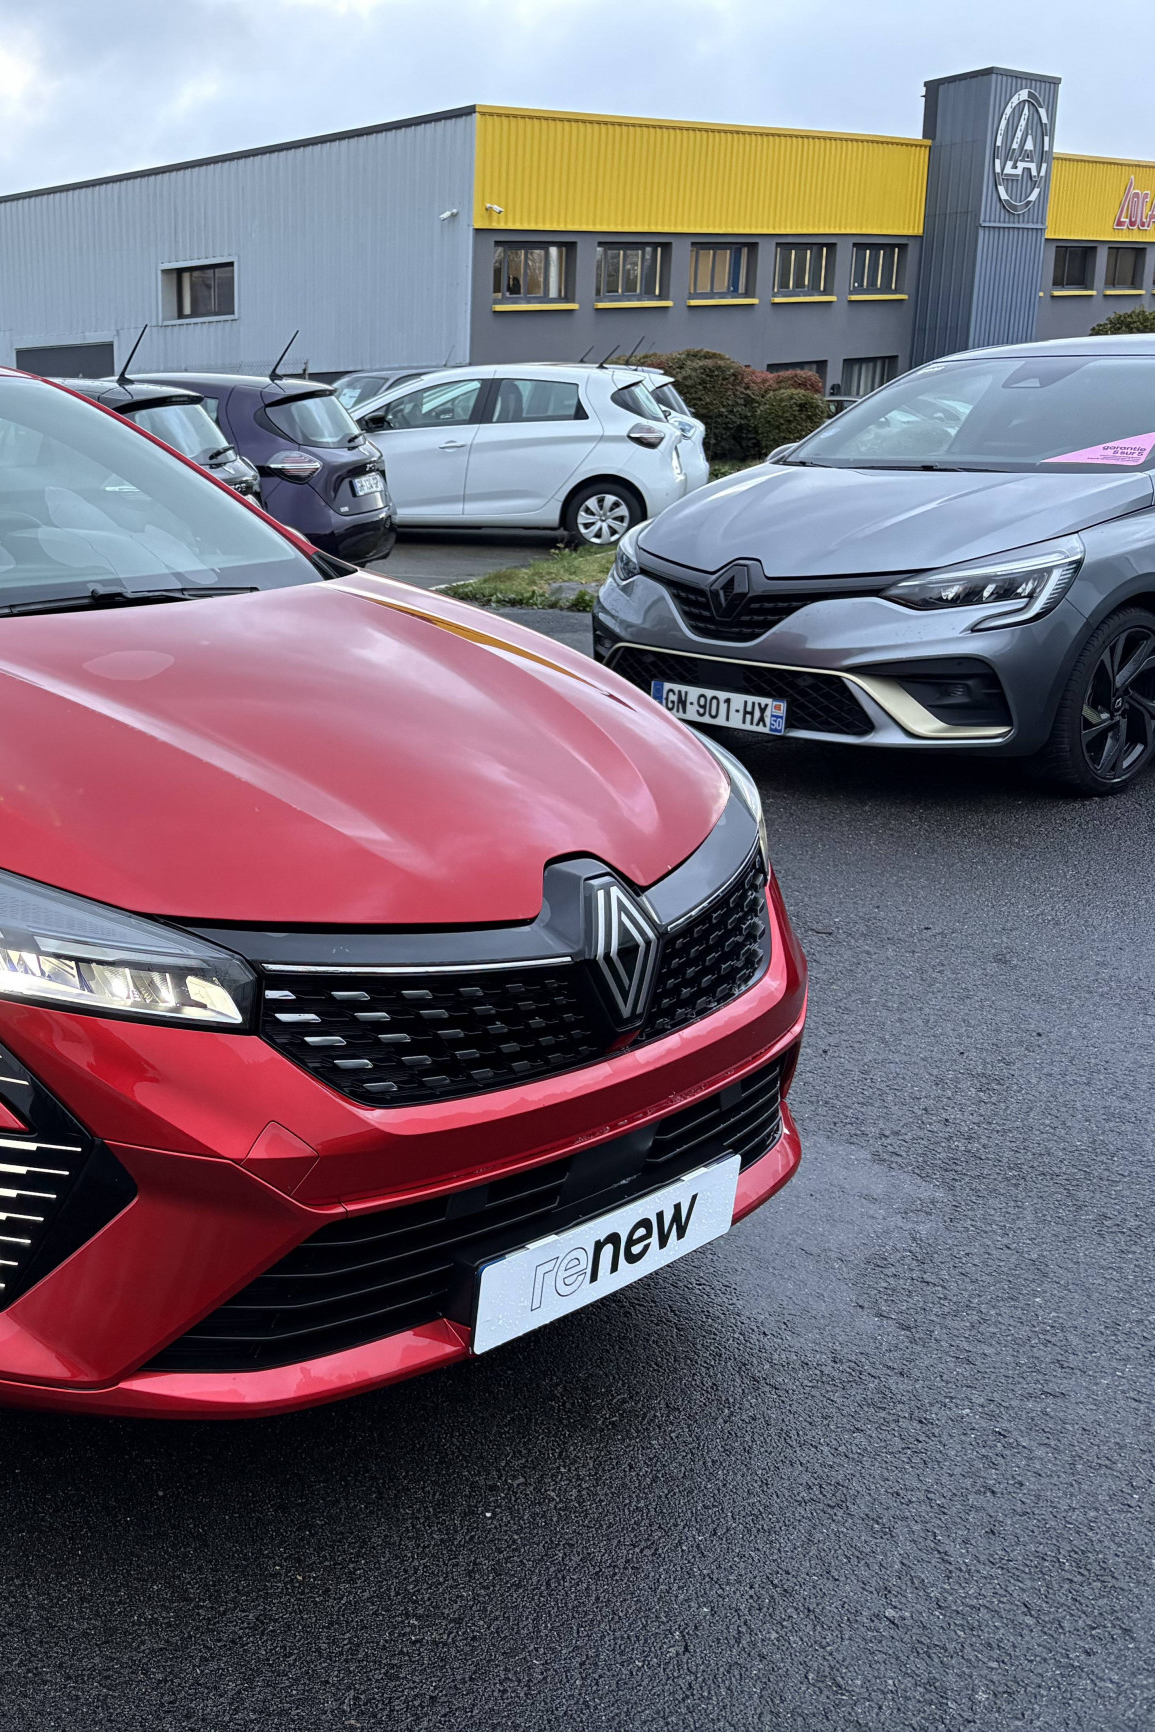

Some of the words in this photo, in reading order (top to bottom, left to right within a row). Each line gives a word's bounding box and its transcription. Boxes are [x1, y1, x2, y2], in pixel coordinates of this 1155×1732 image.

[664, 688, 769, 728] GN-901-HX
[770, 718, 783, 730] 50
[530, 1192, 699, 1312] renew
